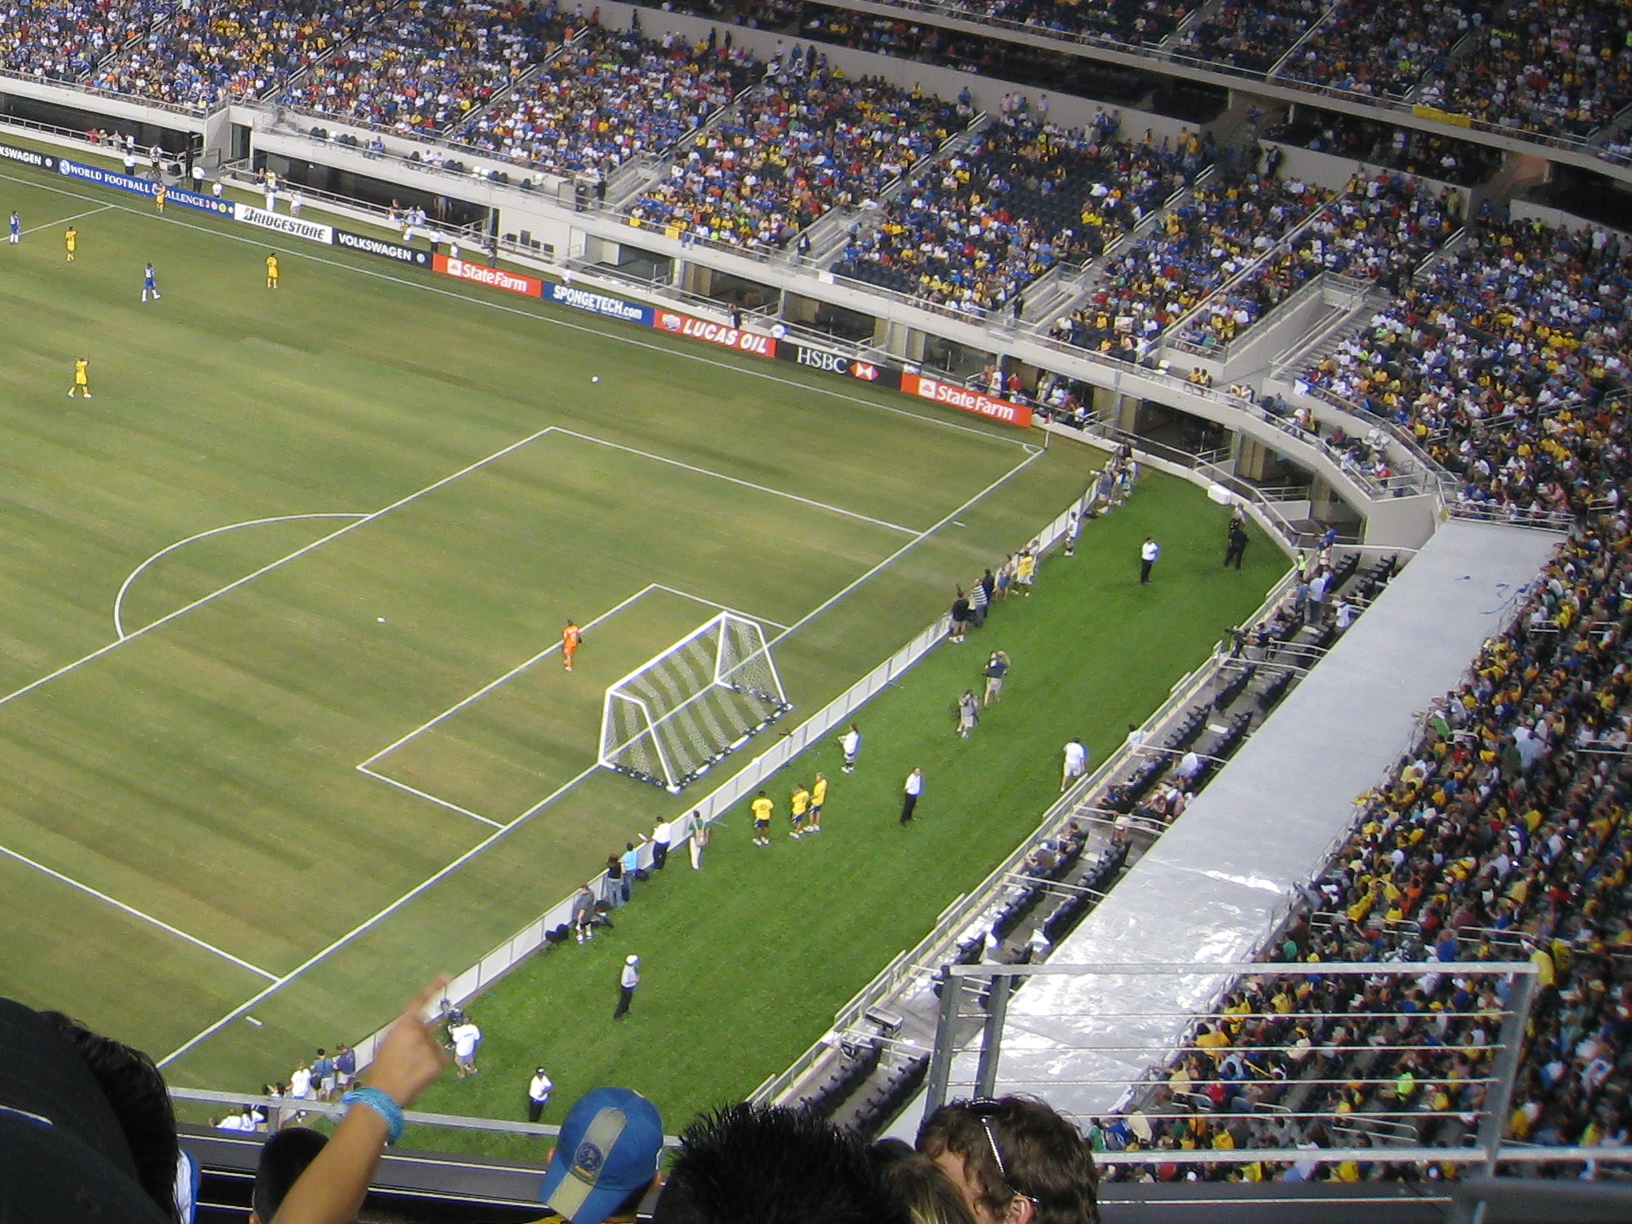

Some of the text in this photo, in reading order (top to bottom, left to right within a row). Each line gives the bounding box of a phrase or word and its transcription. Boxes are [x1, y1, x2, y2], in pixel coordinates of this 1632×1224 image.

[70, 164, 205, 207] WORLD FOOTBALL CALLENGE
[242, 206, 326, 241] BRIDGESTONE
[337, 232, 412, 262] VOLKSWAGEN
[552, 284, 643, 320] SPONGETECH.com
[681, 318, 768, 355] LUCAS OIL
[796, 346, 848, 374] HSBC
